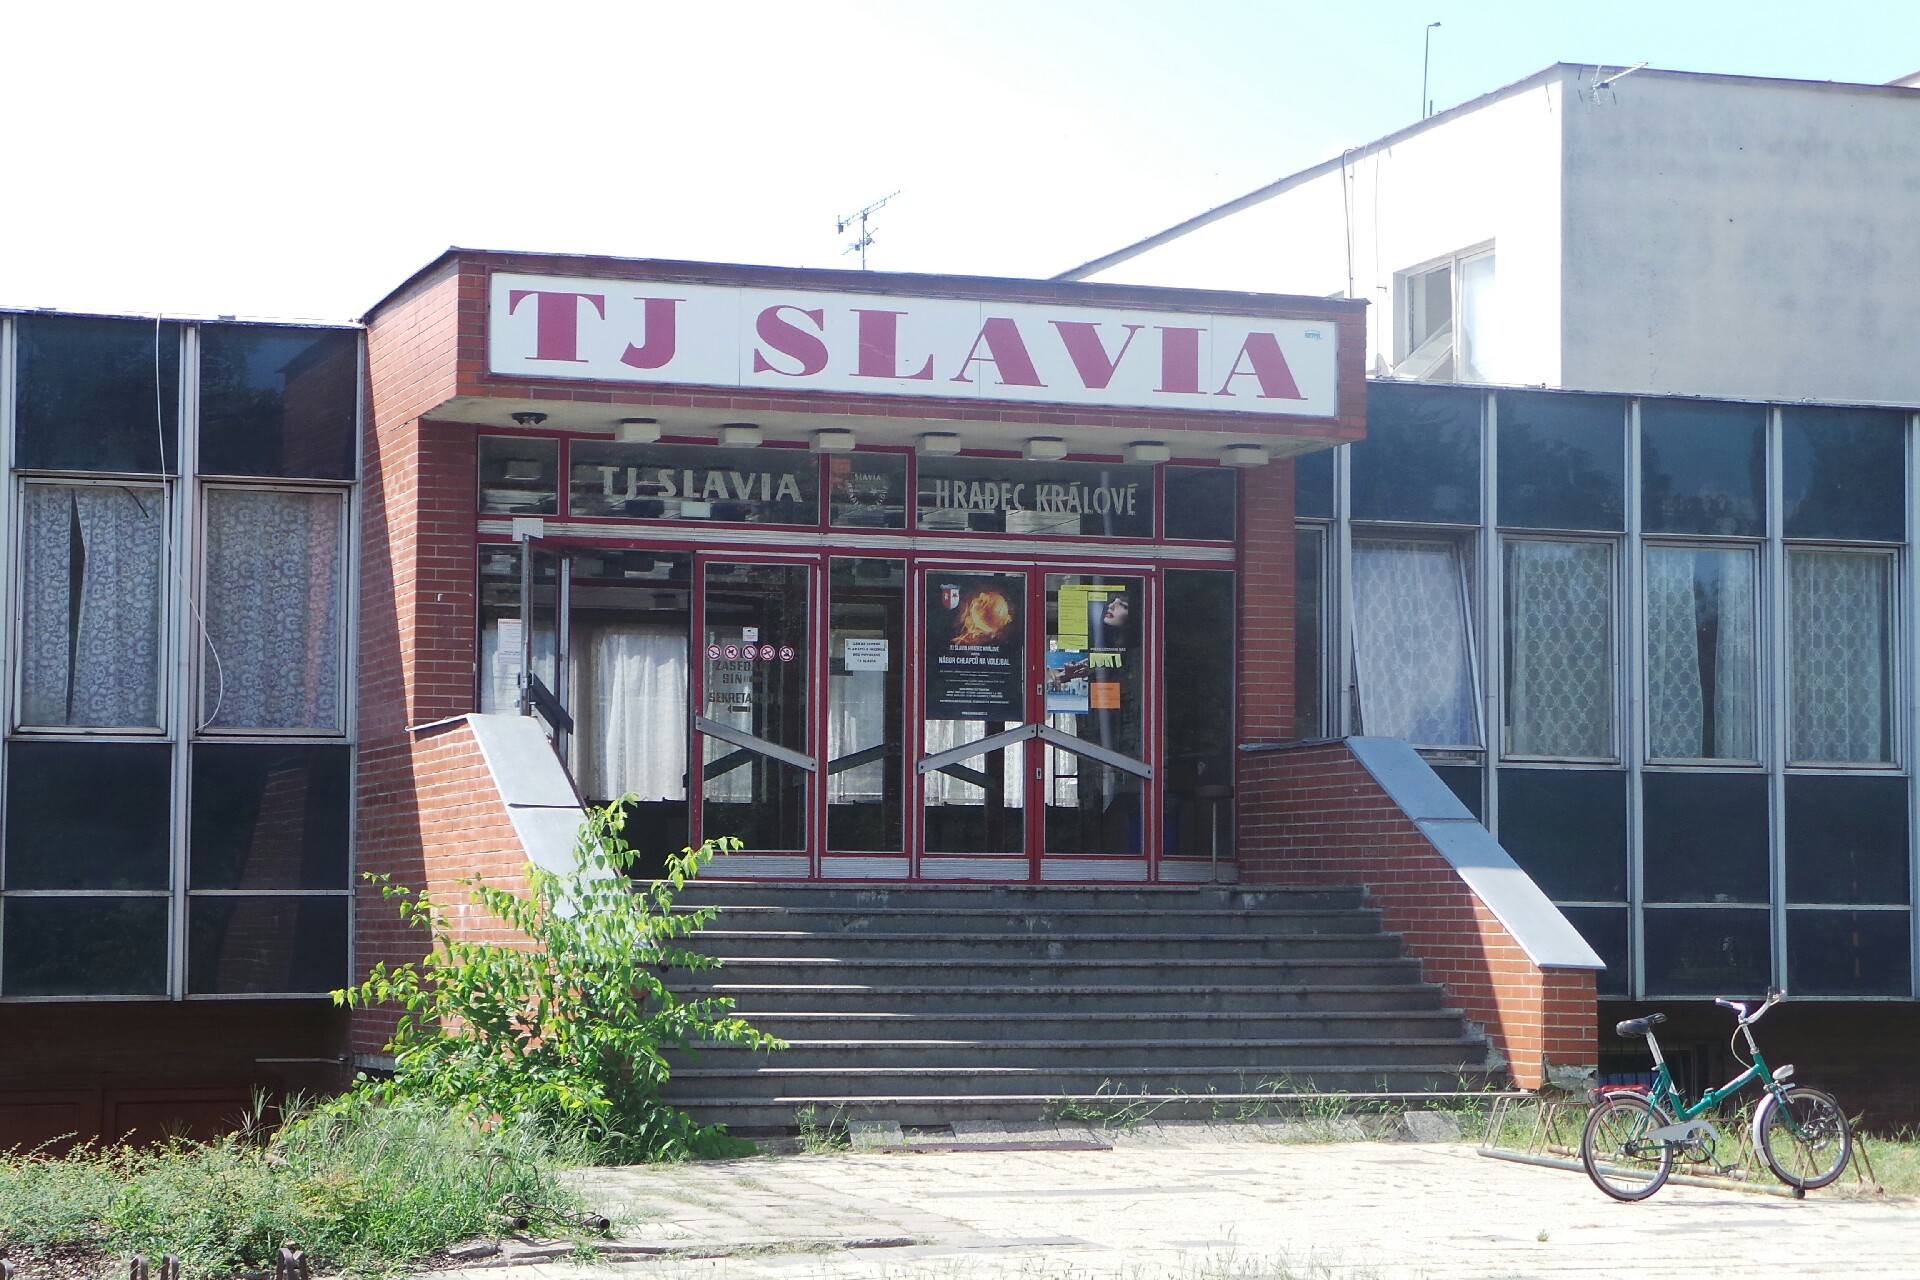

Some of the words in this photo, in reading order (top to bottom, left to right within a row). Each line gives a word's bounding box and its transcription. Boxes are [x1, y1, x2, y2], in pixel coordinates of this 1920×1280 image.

[509, 290, 687, 368] TJ
[754, 304, 1308, 400] SLAVIA
[598, 466, 637, 499] TJ
[658, 468, 803, 502] SLAVIA
[935, 480, 1025, 510] HRADEC
[1036, 482, 1138, 516] KRÁLOVÉ
[979, 657, 986, 665] NA
